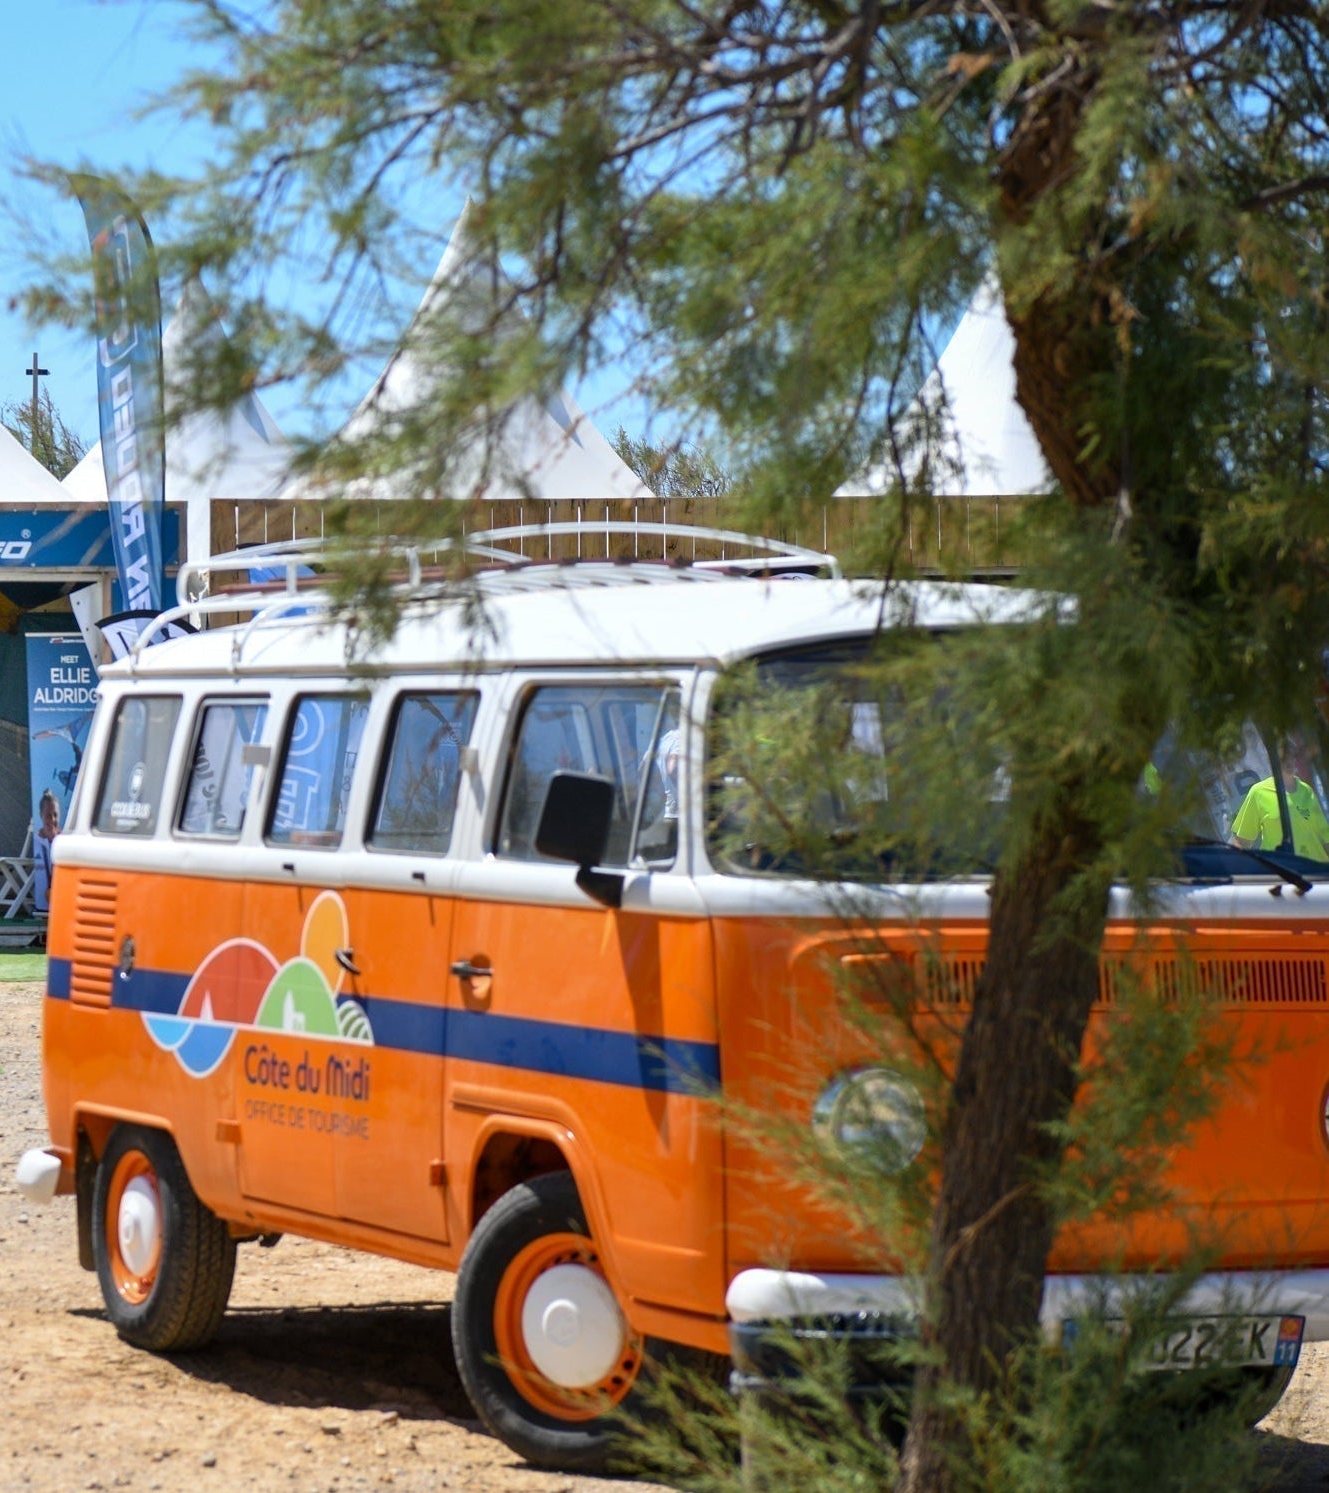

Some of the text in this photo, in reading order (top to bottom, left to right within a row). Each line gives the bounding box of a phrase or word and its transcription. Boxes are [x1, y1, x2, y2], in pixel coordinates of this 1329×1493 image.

[60, 655, 79, 664] MEET
[50, 667, 90, 683] ELLIE
[34, 687, 98, 703] ALDRIDG
[244, 1044, 370, 1101] Côte du Midi
[245, 1098, 370, 1141] OFFICE DE TOURISME
[1278, 1341, 1296, 1361] 11
